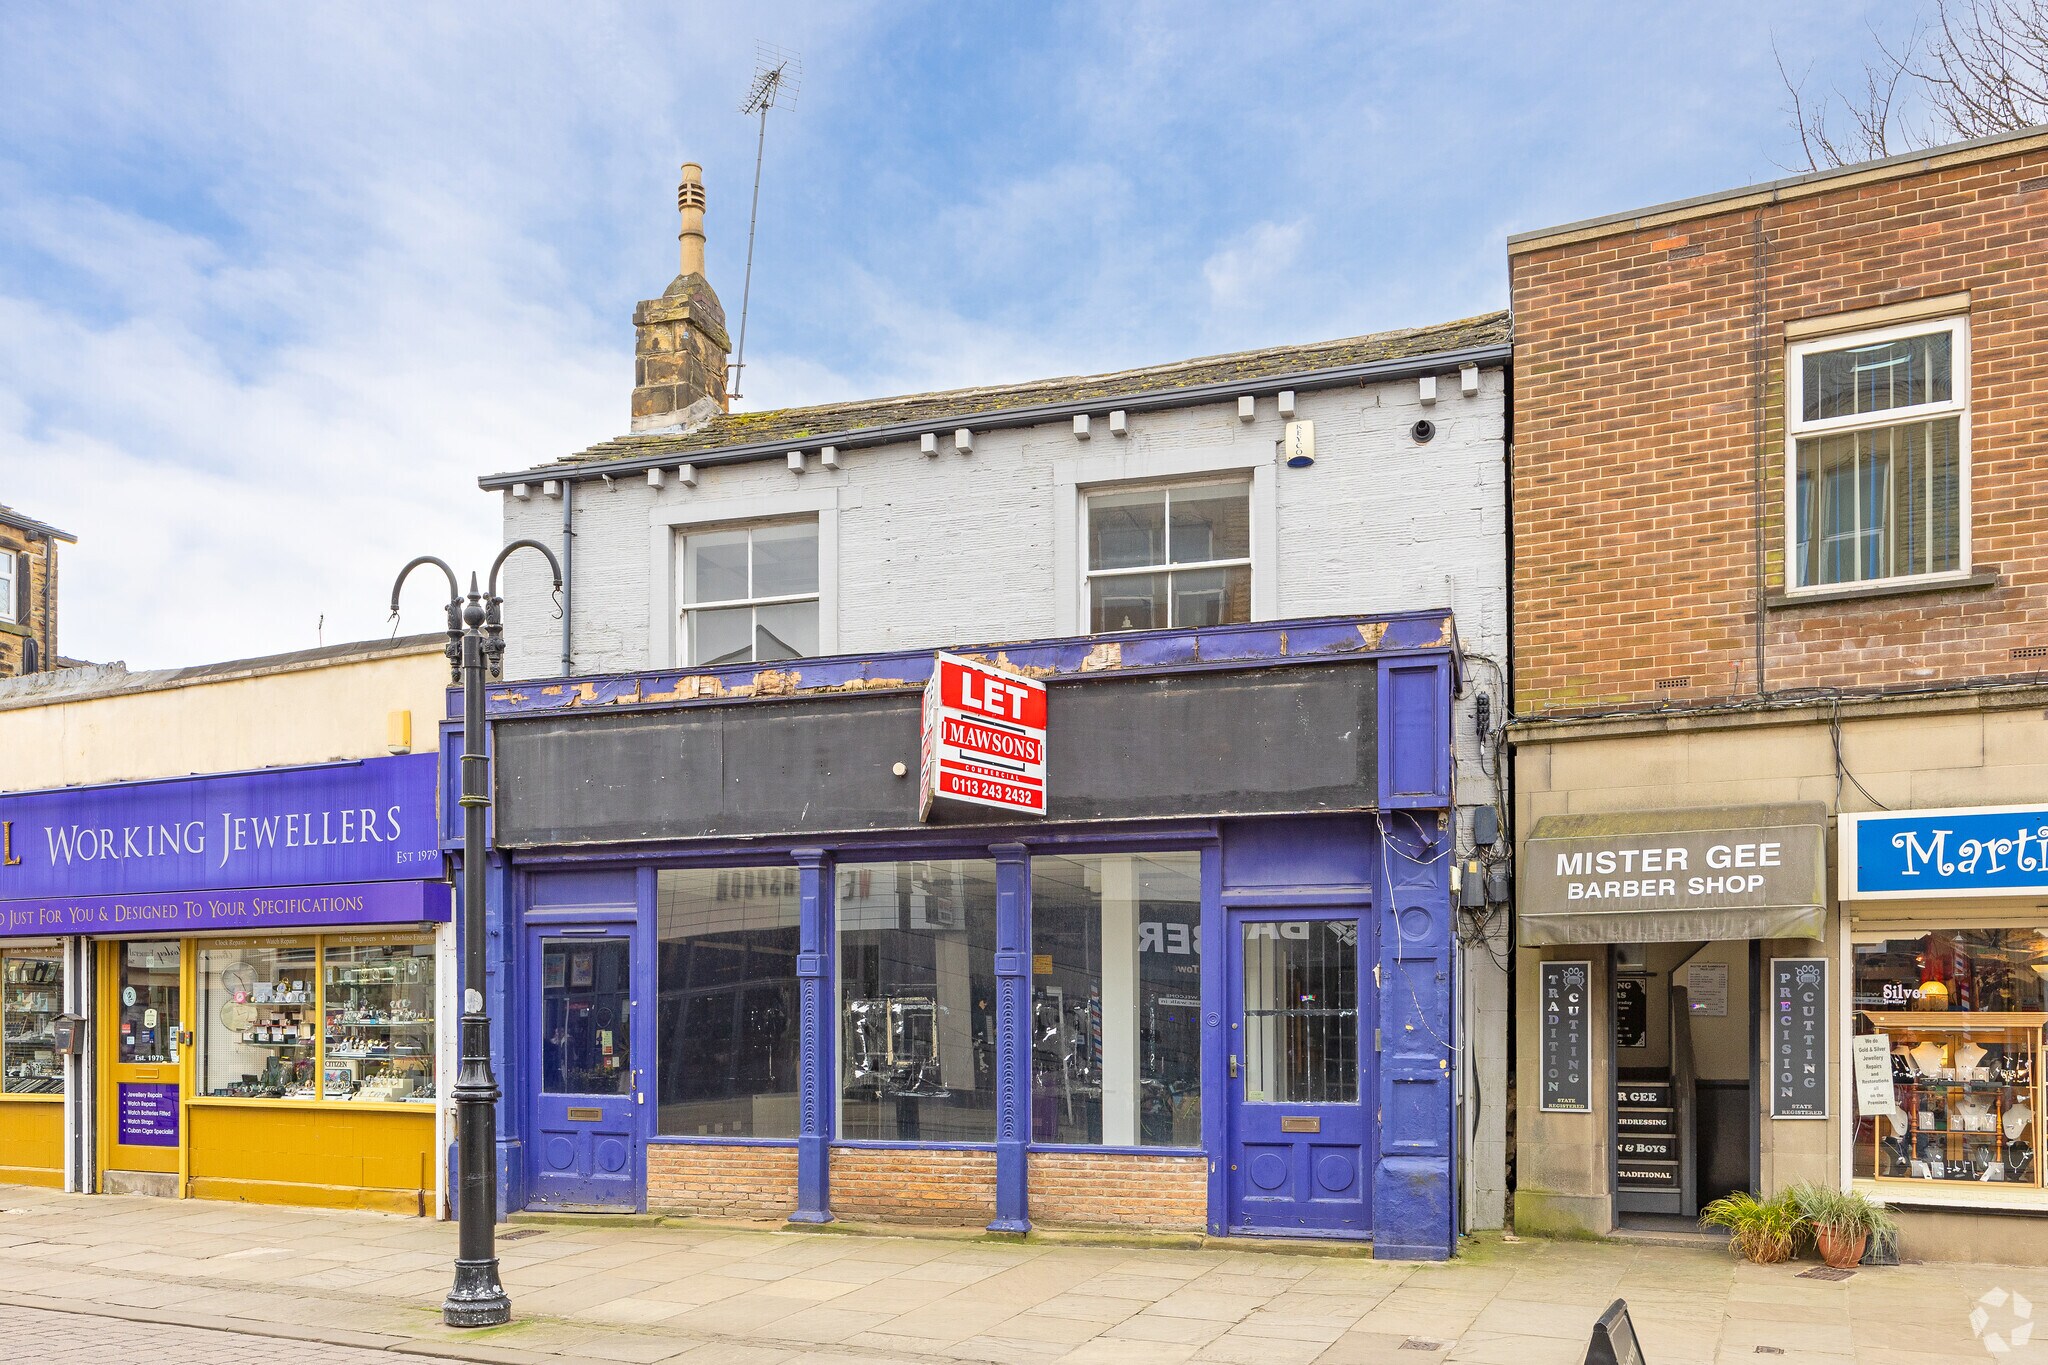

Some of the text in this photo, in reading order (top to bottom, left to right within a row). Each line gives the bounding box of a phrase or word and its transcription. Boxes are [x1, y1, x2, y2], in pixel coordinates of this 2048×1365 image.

[962, 671, 1029, 720] LET
[950, 722, 1036, 760] MAWSONS
[965, 765, 1020, 781] COMMERCIAL
[952, 776, 1032, 805] 0113 243 2432
[43, 821, 206, 867] WORKING
[219, 805, 401, 869] JEWELLERS
[396, 849, 438, 864] EST 1979
[1556, 842, 1782, 876] MISTER GEE
[1567, 874, 1765, 900] BARBER SHOP
[9, 909, 35, 931] JUST
[39, 907, 63, 925] FOR
[68, 906, 94, 924] YOU
[98, 905, 109, 922] &
[115, 903, 179, 923] DESIGNED
[184, 901, 203, 919] TO
[208, 900, 247, 918] YOUR
[252, 896, 364, 917] SPECIFICATIONS
[229, 939, 247, 947] Repairs
[265, 937, 297, 946] Watch Repairs
[1883, 984, 1927, 999] Silver
[1547, 974, 1560, 1092] TRADITION
[1567, 992, 1580, 1084] CUTTING
[1779, 973, 1794, 1098] PRECISION
[1802, 992, 1816, 1089] CUTTING
[148, 1054, 164, 1062] 1979
[141, 1100, 156, 1108] Repairs
[1629, 1092, 1657, 1102] GEE
[141, 1127, 154, 1135] Cigar
[1617, 1118, 1667, 1126] IRDRESSING
[1624, 1144, 1635, 1152] &
[1636, 1143, 1667, 1153] BOYS
